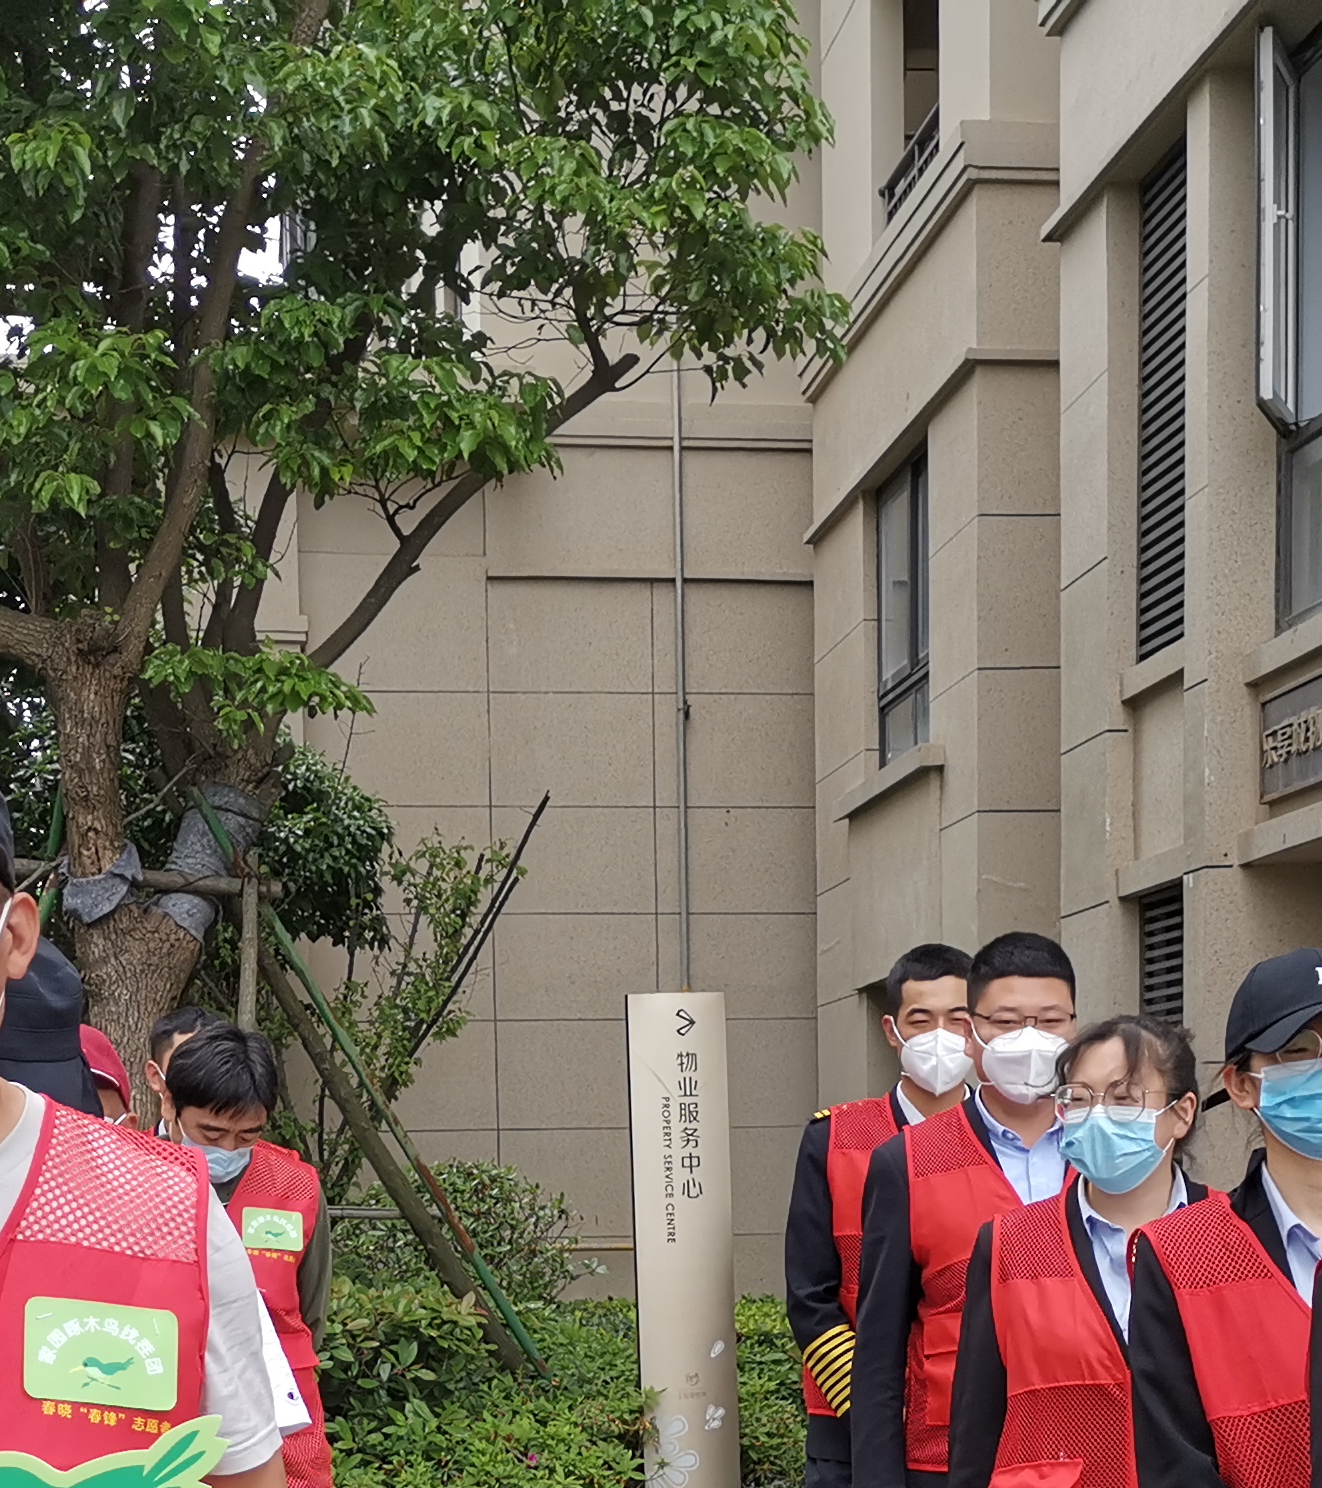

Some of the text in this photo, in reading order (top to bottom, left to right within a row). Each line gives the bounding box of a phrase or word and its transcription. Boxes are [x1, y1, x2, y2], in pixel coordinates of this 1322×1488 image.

[661, 1096, 677, 1244] PROPERTY SERVICE CENTRE
[676, 1051, 703, 1199] 物业服务中心
[37, 1315, 164, 1376] 家园啄木鸟找茬团
